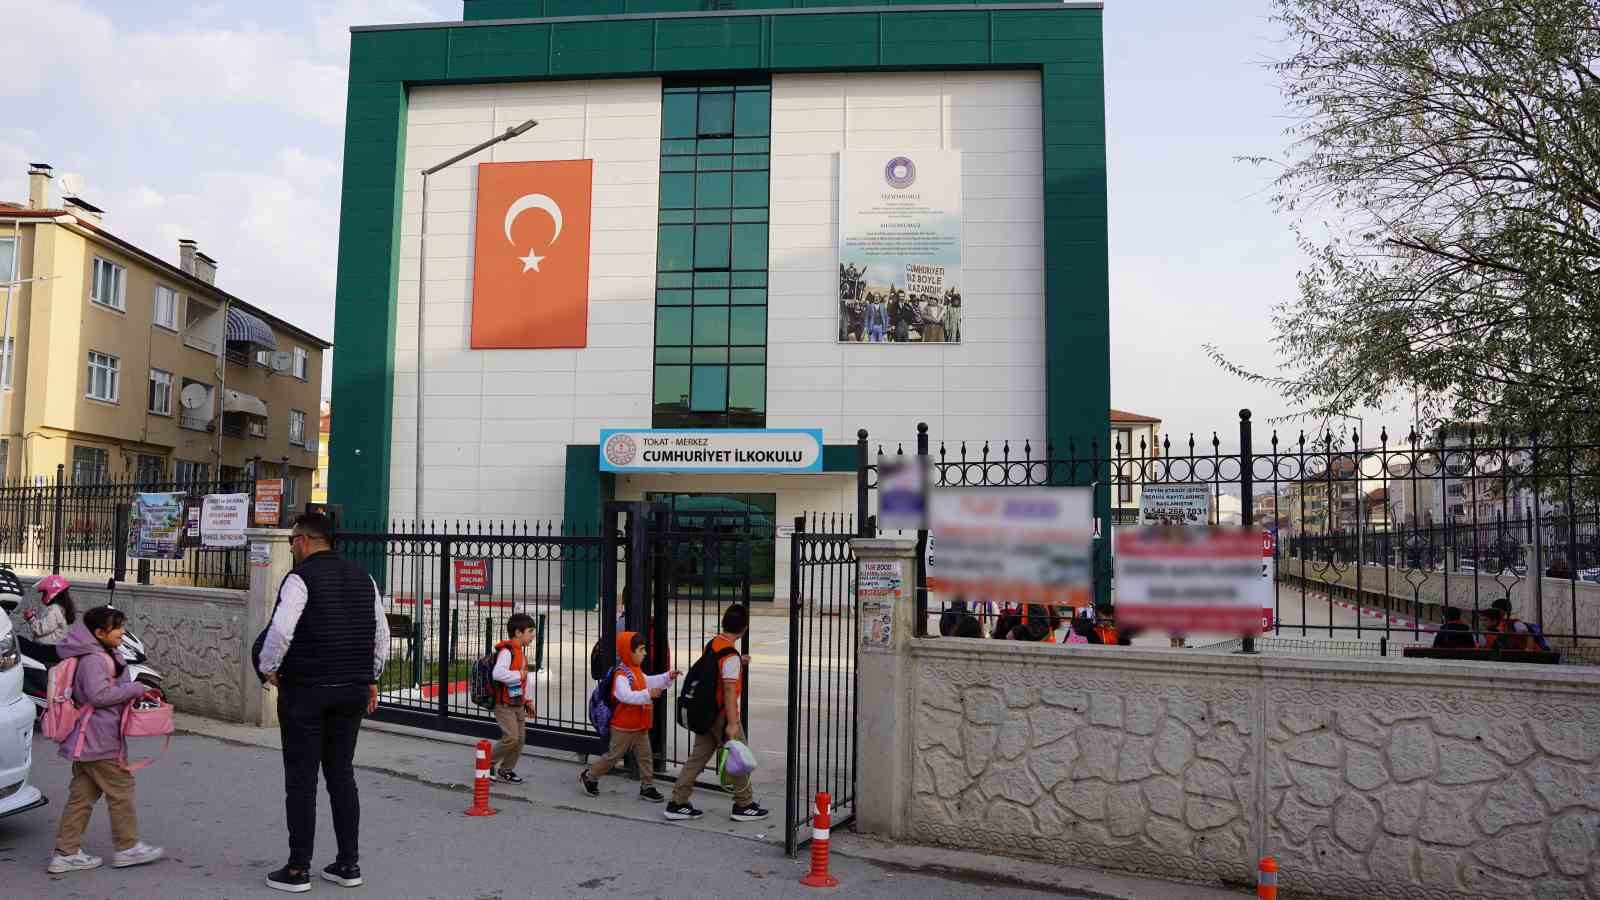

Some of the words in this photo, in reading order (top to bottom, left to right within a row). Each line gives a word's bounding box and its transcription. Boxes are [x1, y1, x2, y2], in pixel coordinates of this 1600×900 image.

[643, 438, 669, 446] TOKAT
[676, 438, 709, 446] MERKEZ
[643, 448, 732, 462] CUMHURİYET
[735, 448, 802, 462] İLKOKULU
